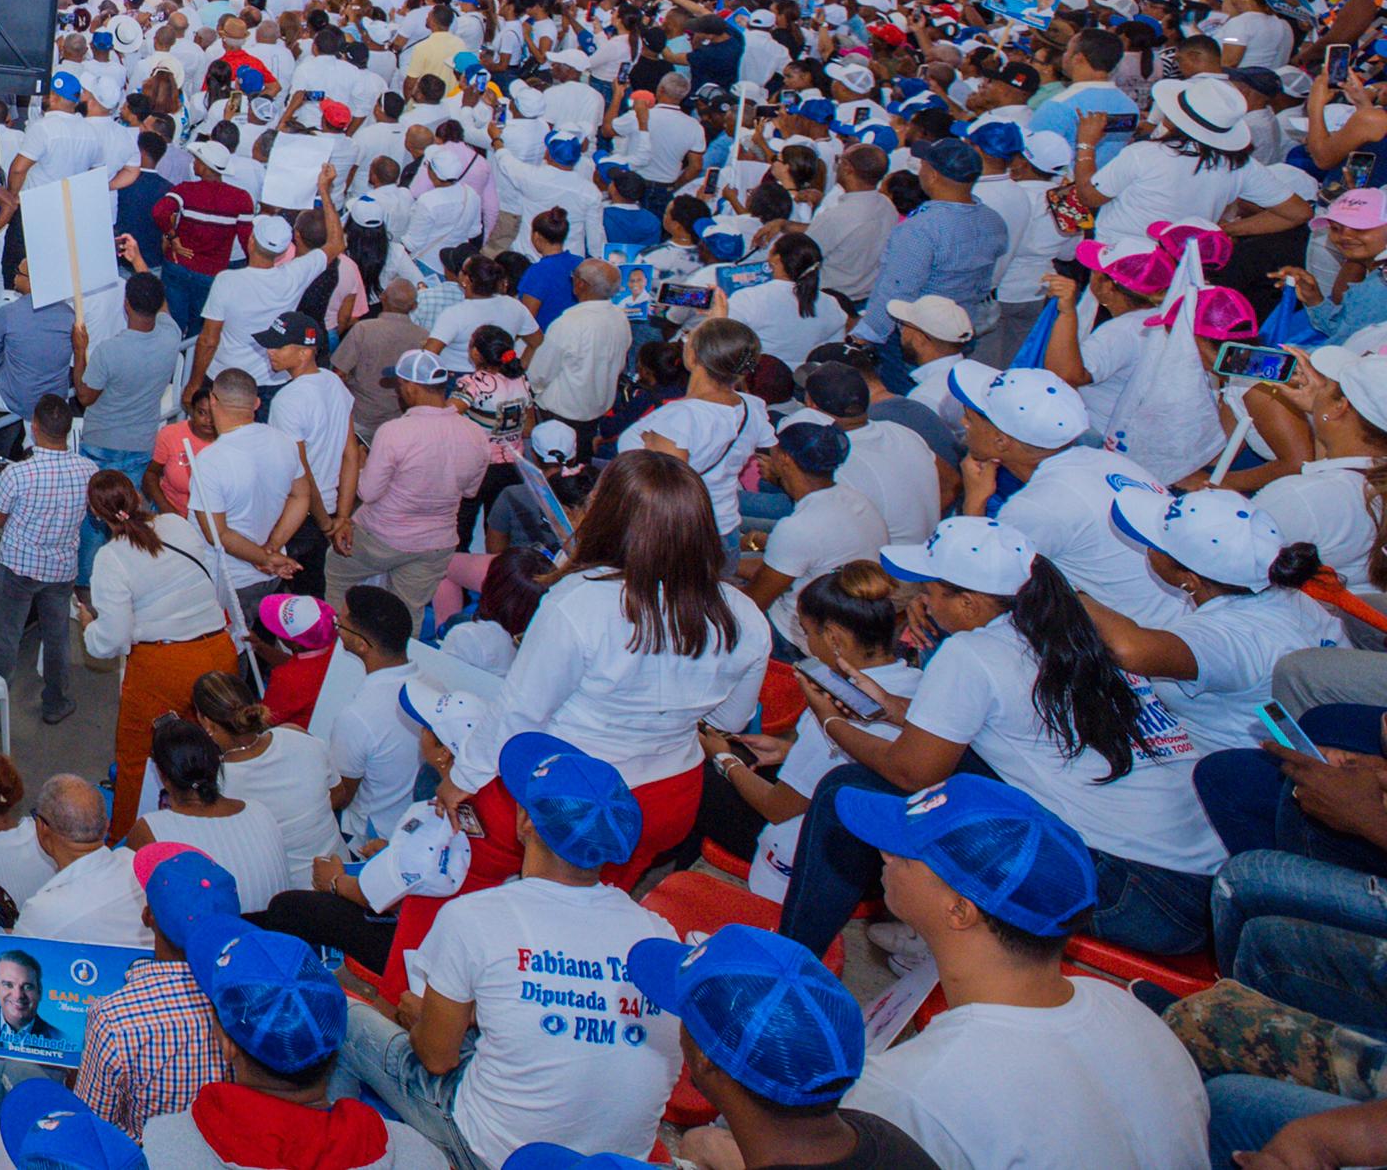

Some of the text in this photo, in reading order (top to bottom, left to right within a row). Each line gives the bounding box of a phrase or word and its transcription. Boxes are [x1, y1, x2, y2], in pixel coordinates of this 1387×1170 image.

[517, 948, 635, 983] Fabiana Ta
[49, 989, 79, 1003] SAN
[520, 981, 607, 1012] Diputada
[24, 1032, 78, 1052] Abinader
[573, 1016, 617, 1045] PRM
[8, 1044, 64, 1059] PRESIDENTE
